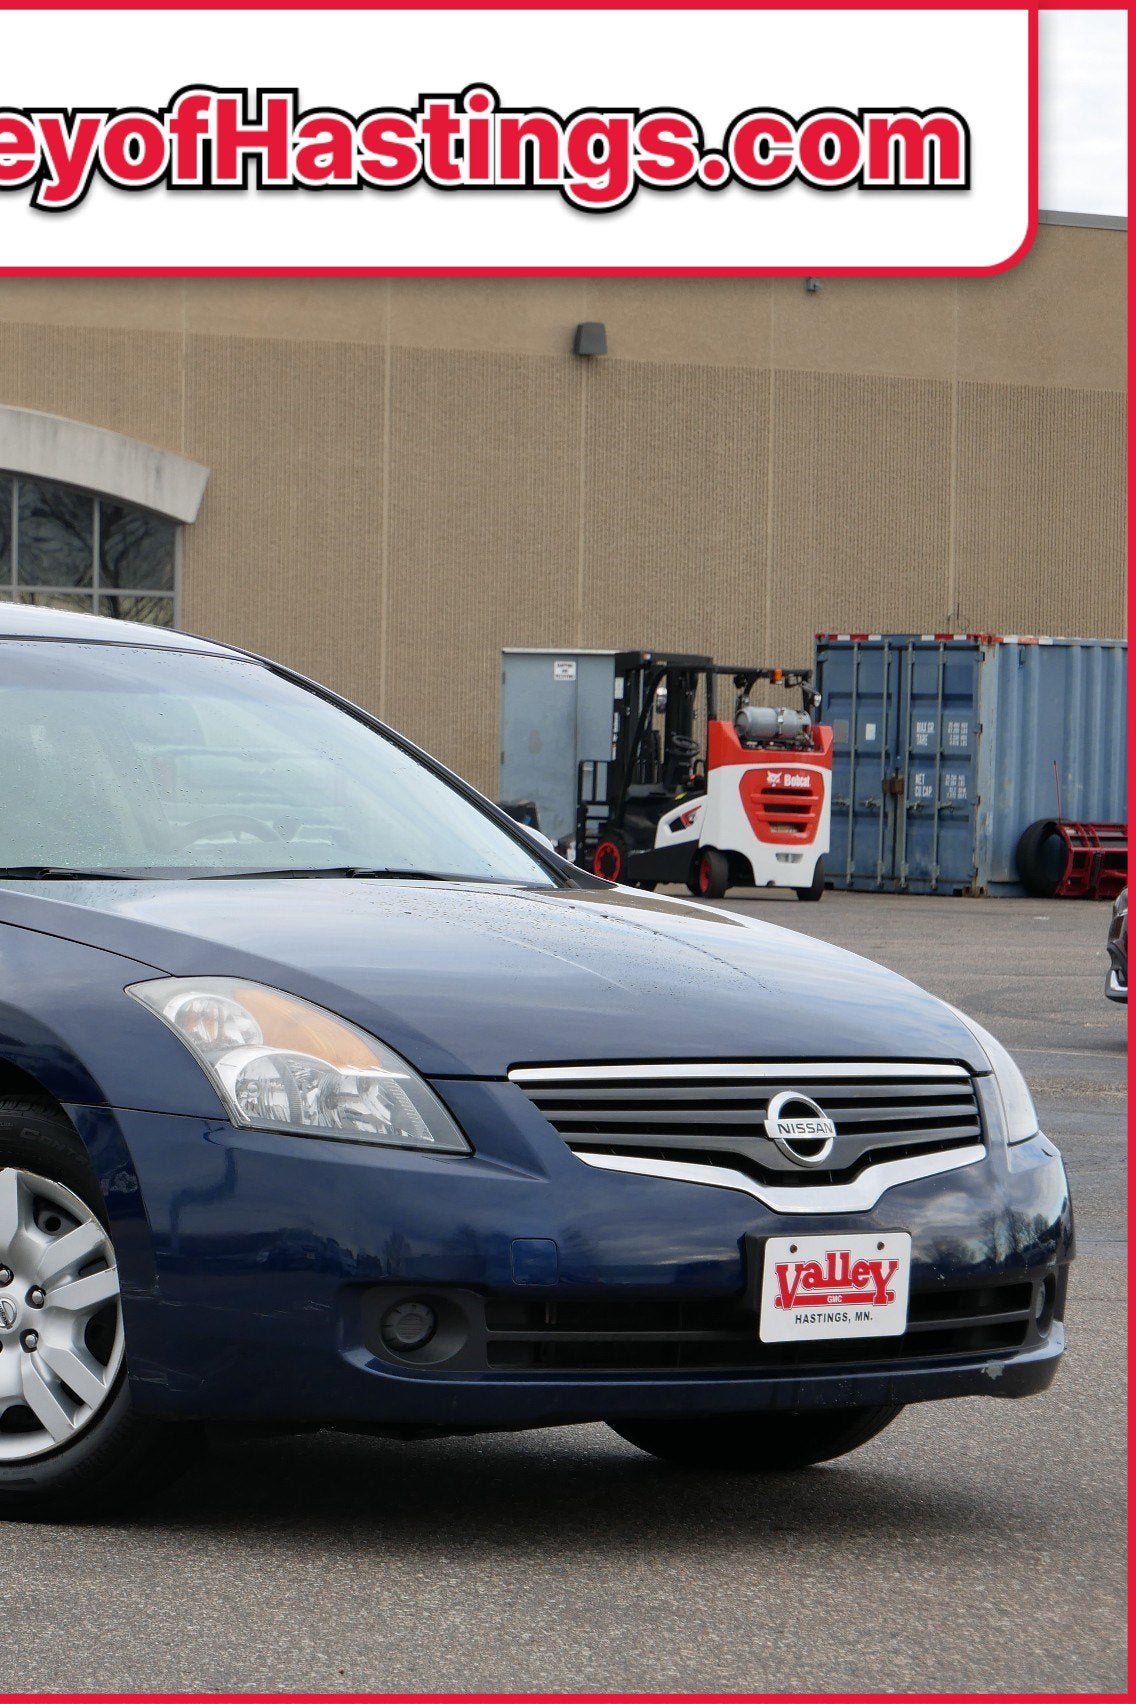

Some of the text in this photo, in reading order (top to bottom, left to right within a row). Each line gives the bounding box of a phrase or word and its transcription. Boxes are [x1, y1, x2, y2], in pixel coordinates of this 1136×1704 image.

[783, 773, 811, 788] Bobcat
[778, 1121, 834, 1134] NISSAN
[774, 1249, 900, 1311] Valley
[826, 1294, 843, 1304] GMC
[795, 1311, 874, 1325] HASTINGS, MN.
